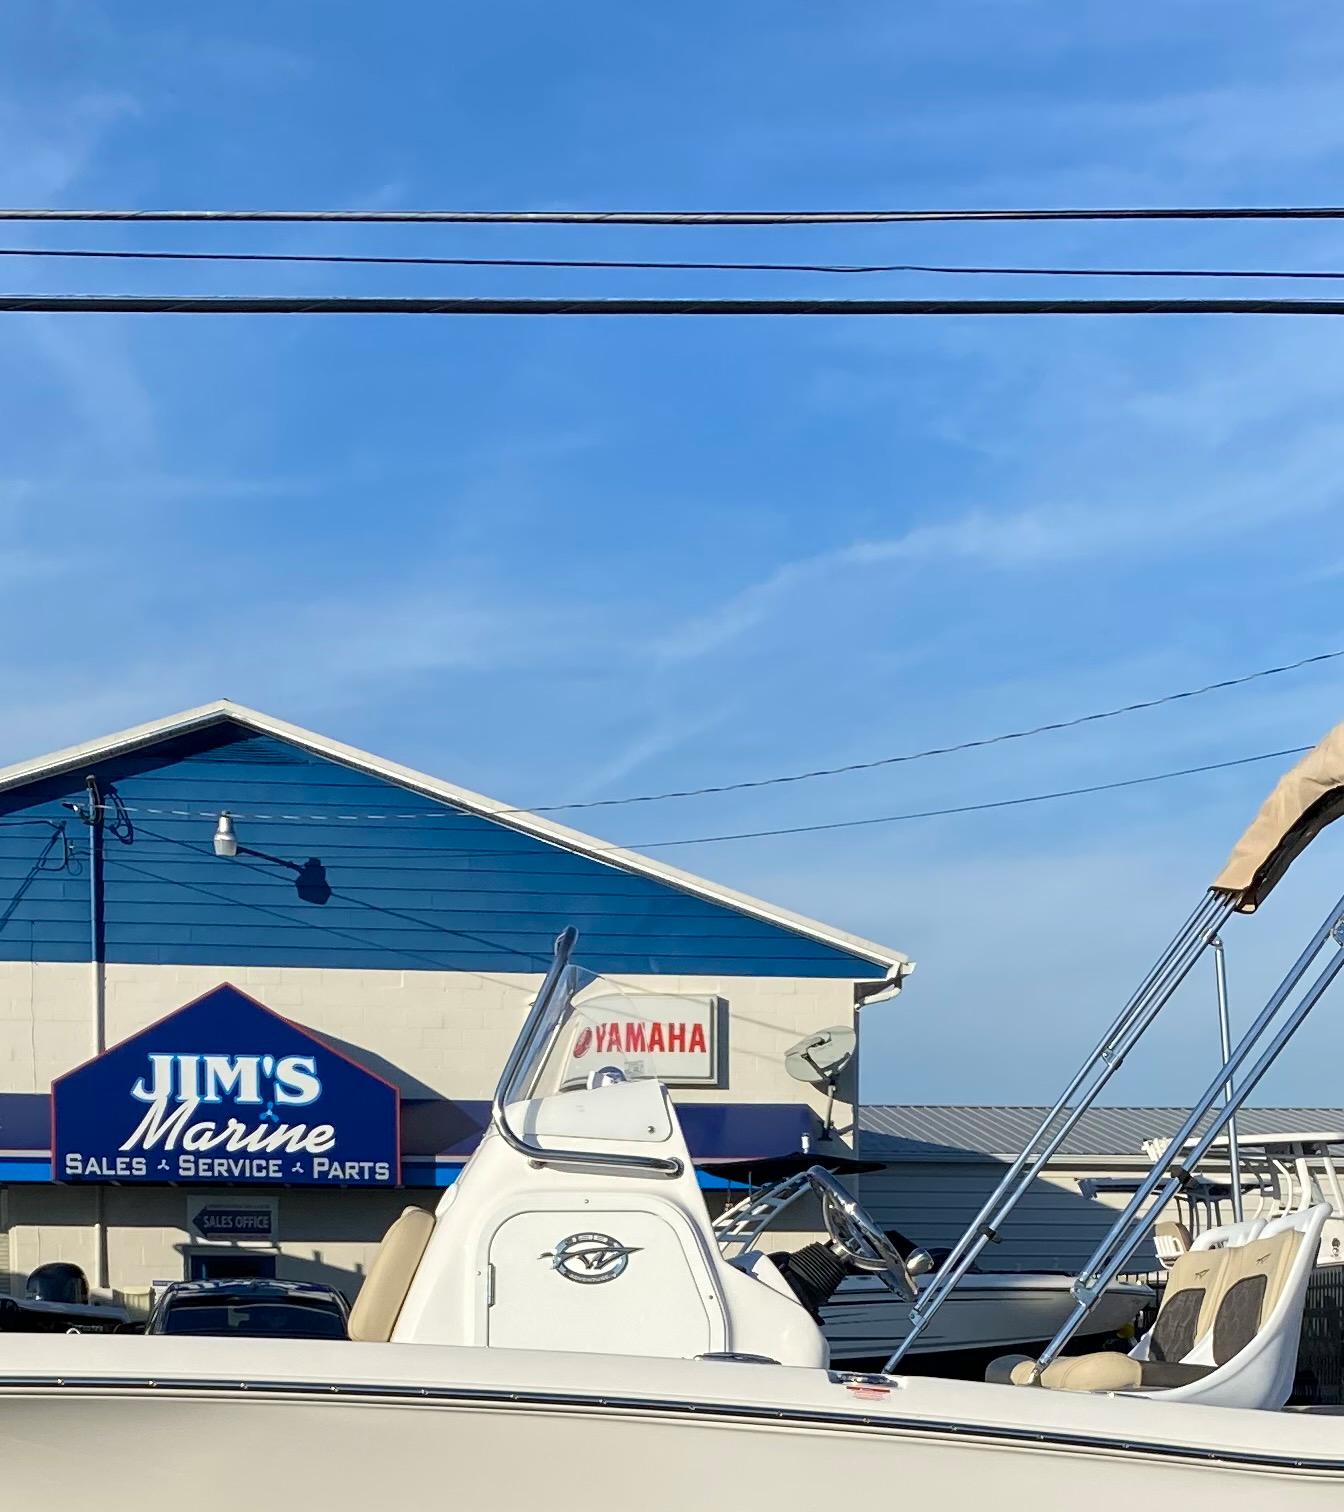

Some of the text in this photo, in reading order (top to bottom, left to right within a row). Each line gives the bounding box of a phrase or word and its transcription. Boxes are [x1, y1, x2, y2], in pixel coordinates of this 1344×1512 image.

[596, 1022, 707, 1053] YAMAHA
[131, 1053, 322, 1105] JIM'S
[118, 1096, 336, 1152] Marine
[65, 1153, 390, 1180] SALES SERVICE PARTS
[203, 1215, 269, 1229] SALES OFFICE
